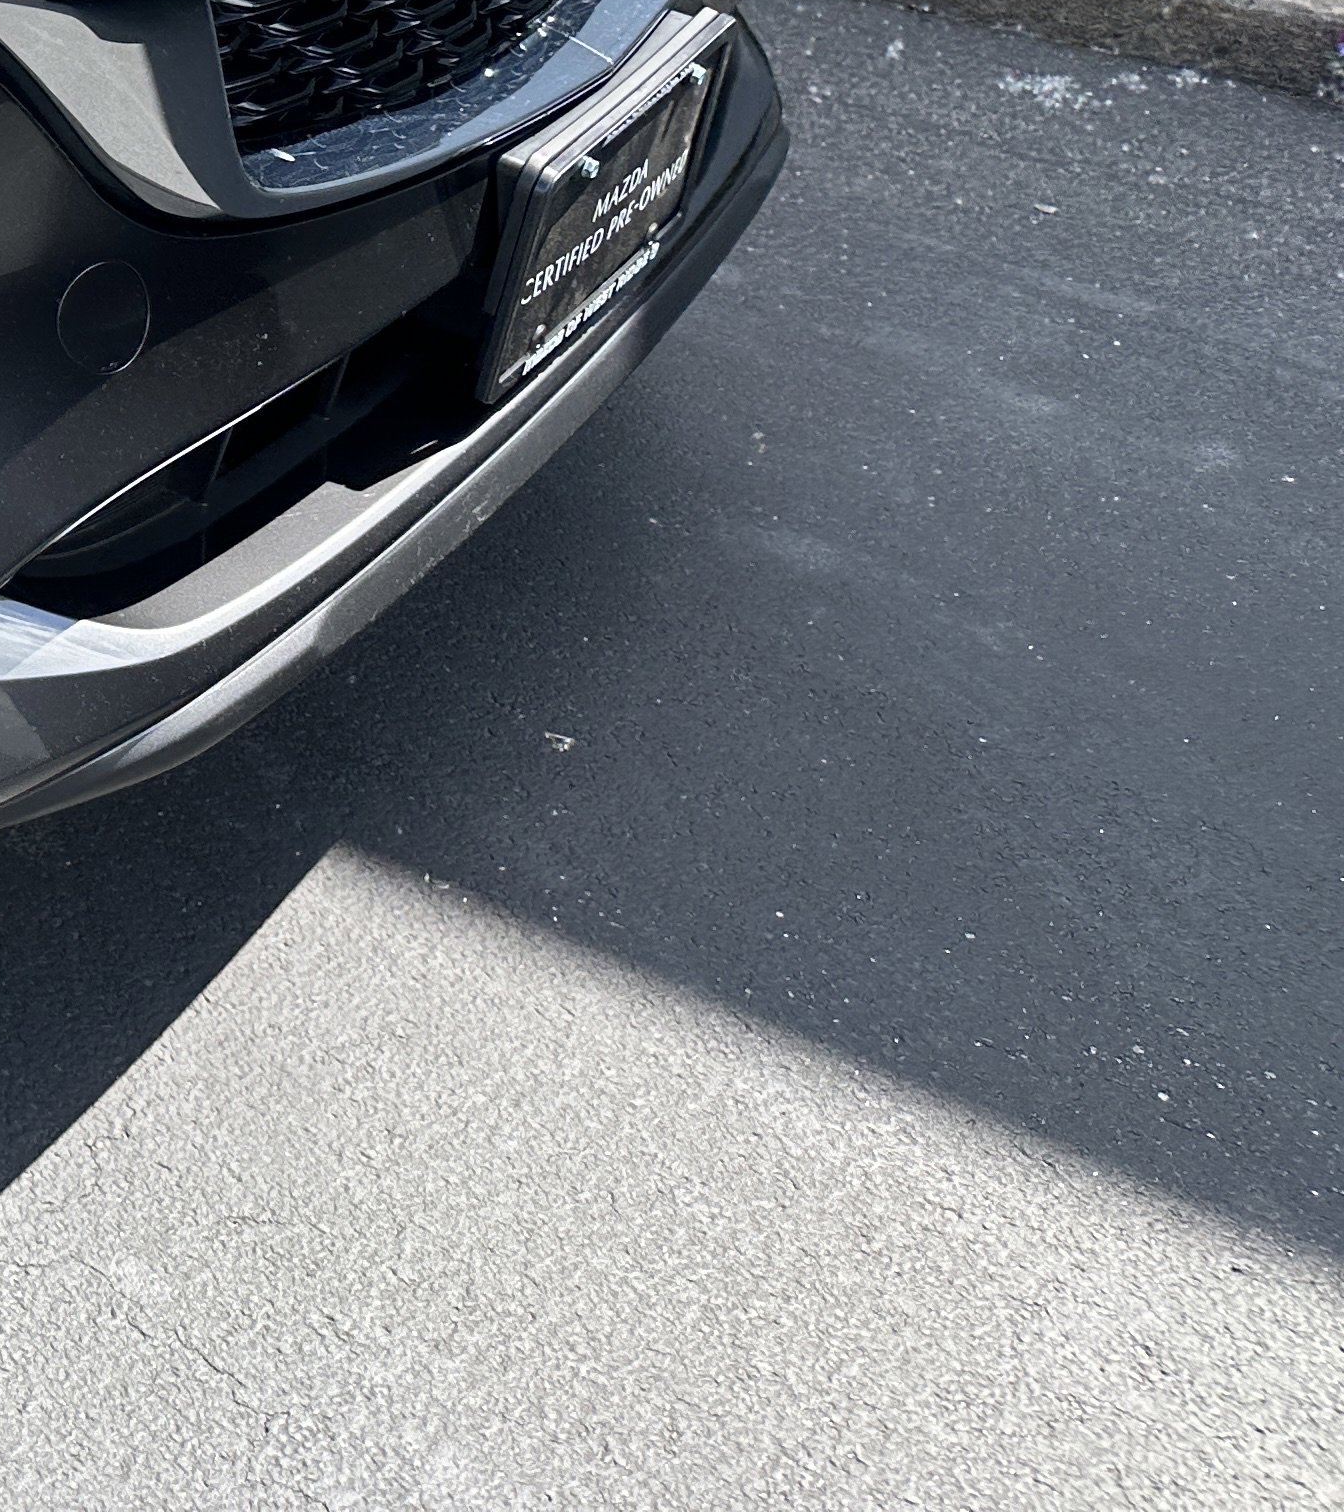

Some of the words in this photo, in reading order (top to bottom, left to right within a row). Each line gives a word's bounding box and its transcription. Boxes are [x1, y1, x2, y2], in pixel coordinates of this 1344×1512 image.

[520, 227, 605, 305] CERTIFIED
[605, 148, 689, 241] PRE-OWNED
[592, 158, 649, 223] MAZDA
